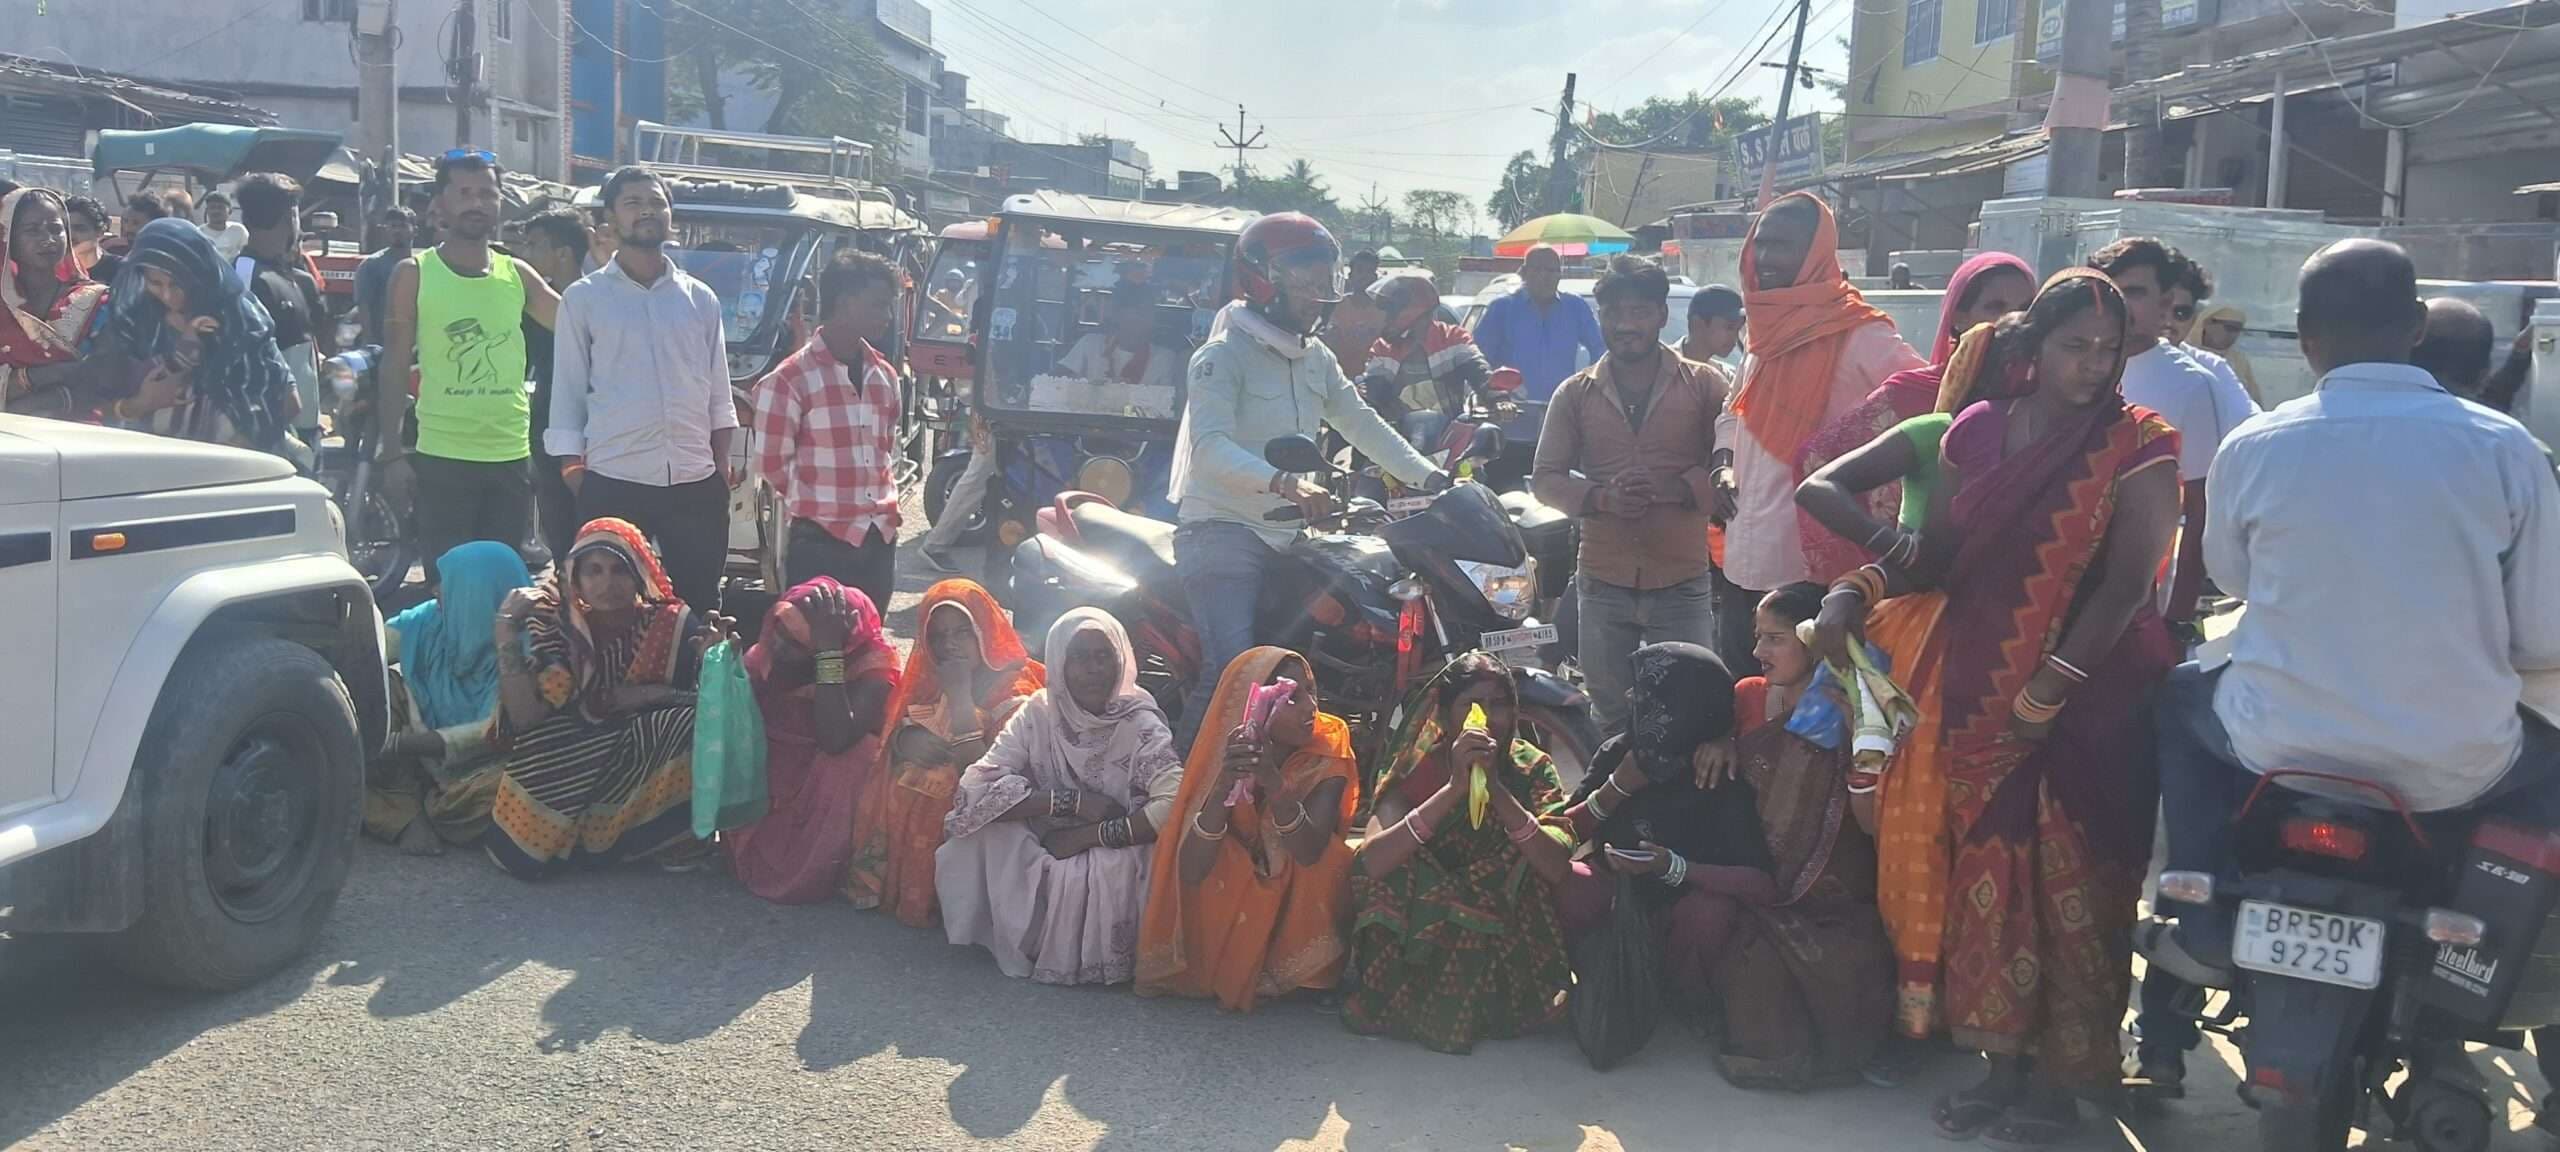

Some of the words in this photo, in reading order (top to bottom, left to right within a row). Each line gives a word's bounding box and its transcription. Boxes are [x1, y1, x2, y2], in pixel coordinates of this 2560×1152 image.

[2265, 908, 2366, 949] BR50K
[2270, 940, 2350, 975] 9225
[2436, 943, 2498, 983] Steelbird
